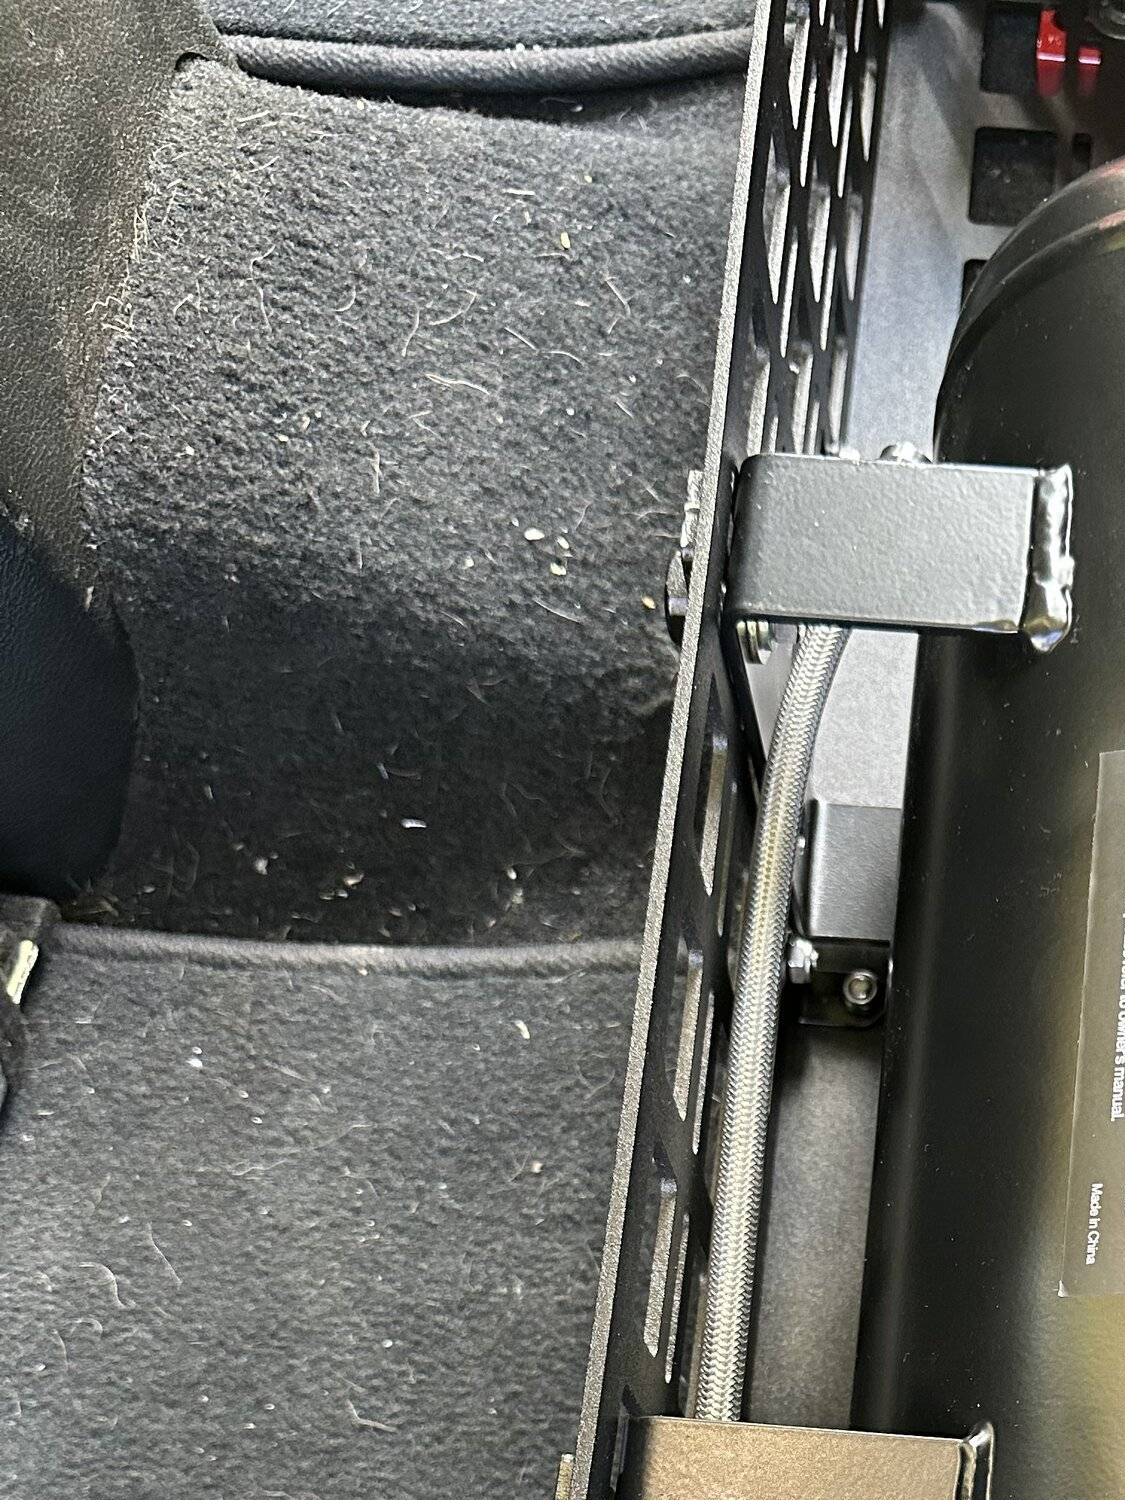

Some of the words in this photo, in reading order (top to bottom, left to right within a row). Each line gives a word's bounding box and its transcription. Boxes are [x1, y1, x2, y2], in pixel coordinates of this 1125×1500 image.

[1111, 1066, 1124, 1120] manual.
[1090, 1182, 1103, 1215] Made
[1089, 1217, 1100, 1228] in
[1086, 1230, 1099, 1263] China
